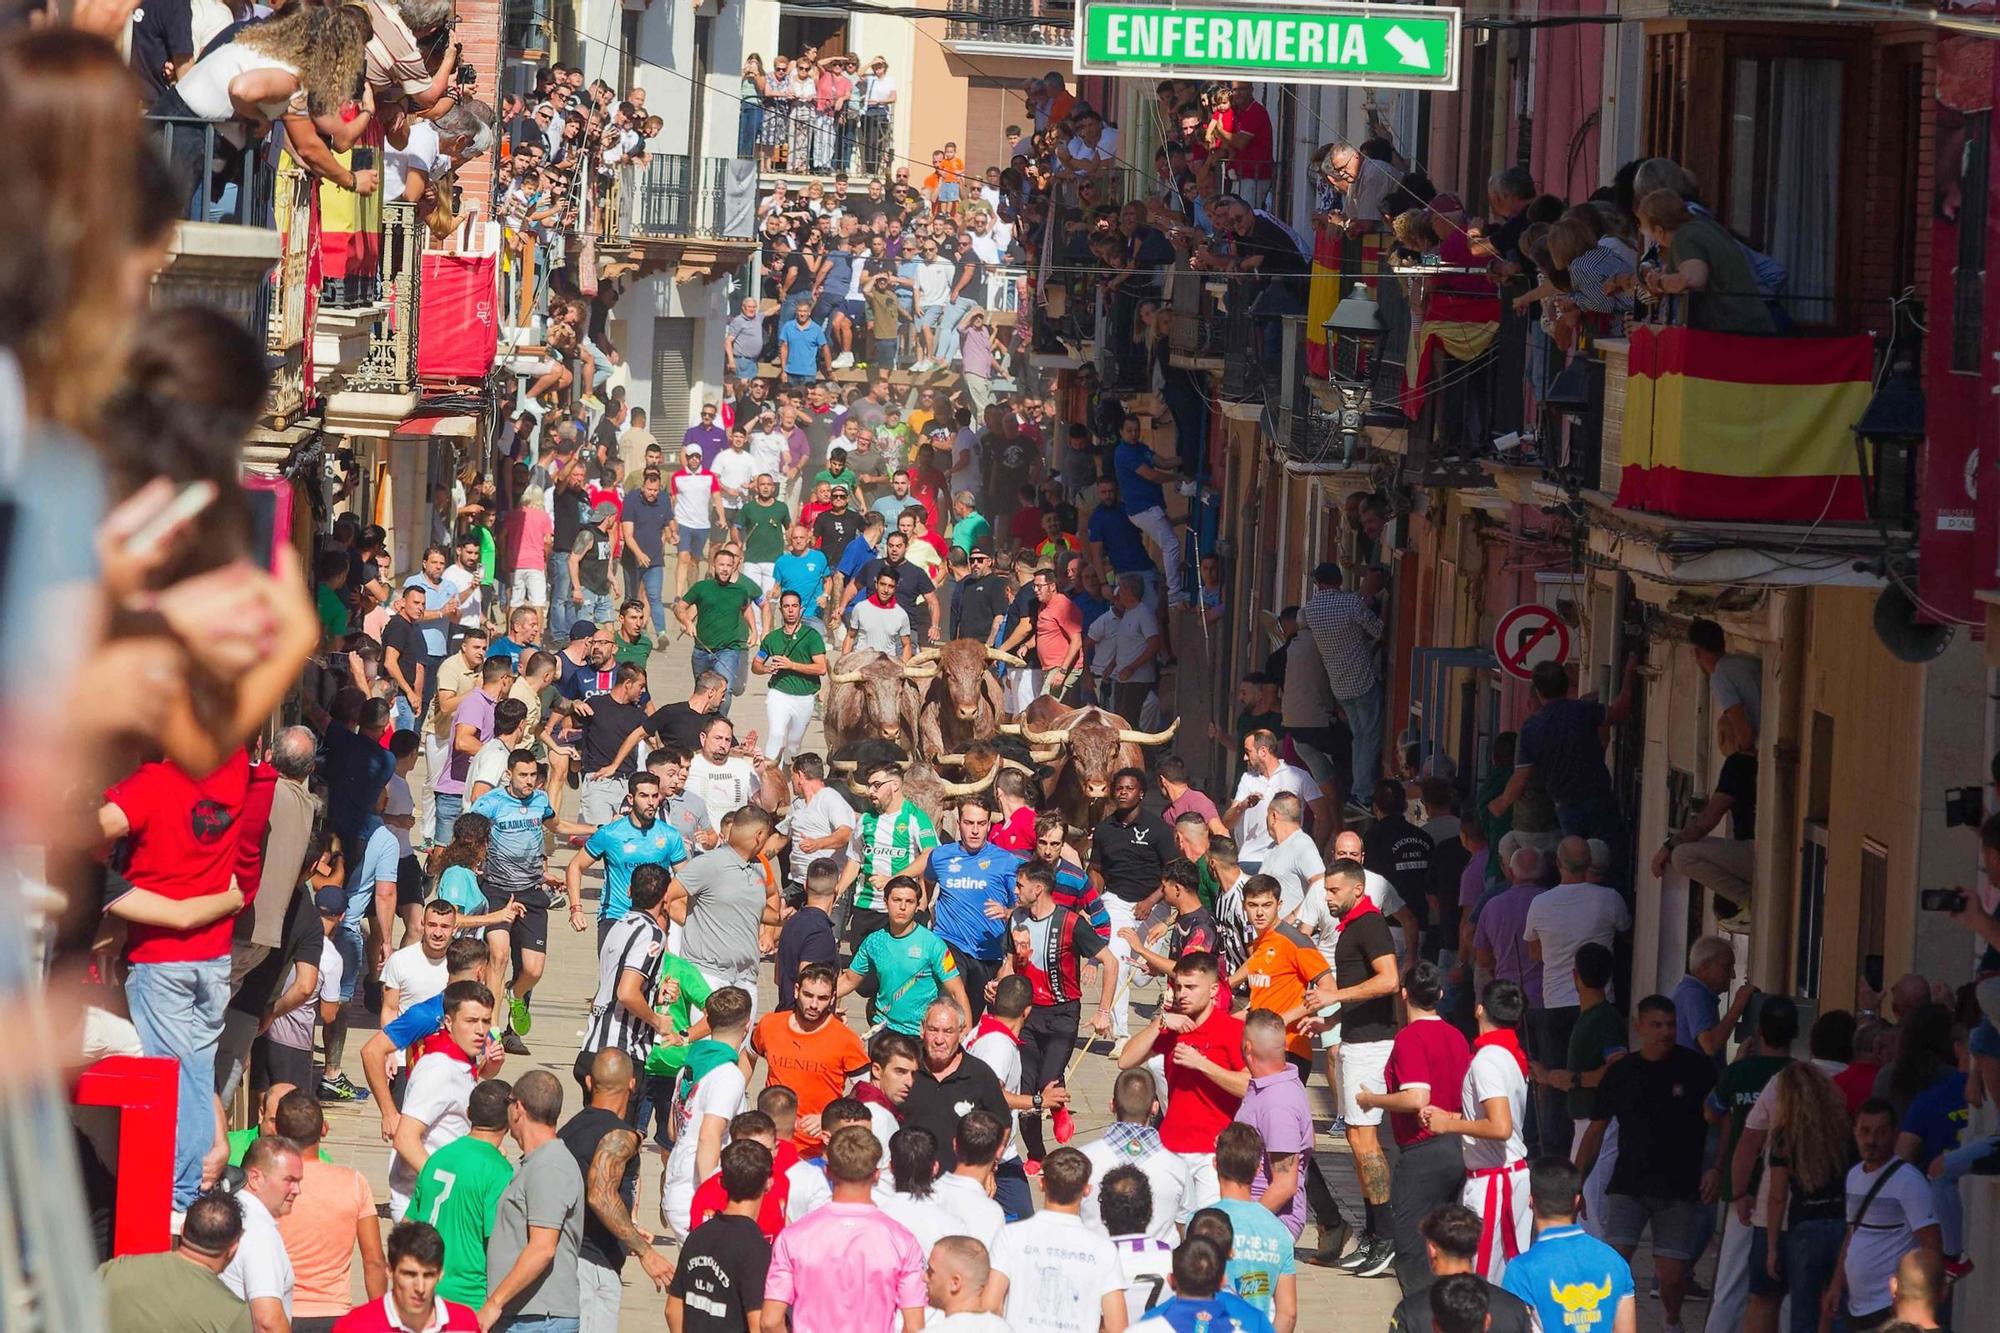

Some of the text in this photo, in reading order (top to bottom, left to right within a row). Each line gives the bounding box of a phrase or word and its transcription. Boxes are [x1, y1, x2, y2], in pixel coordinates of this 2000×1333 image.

[1106, 13, 1369, 66] ENFERMERIA
[945, 877, 988, 890] satine
[428, 1167, 457, 1228] 7
[1134, 1273, 1165, 1312] 7
